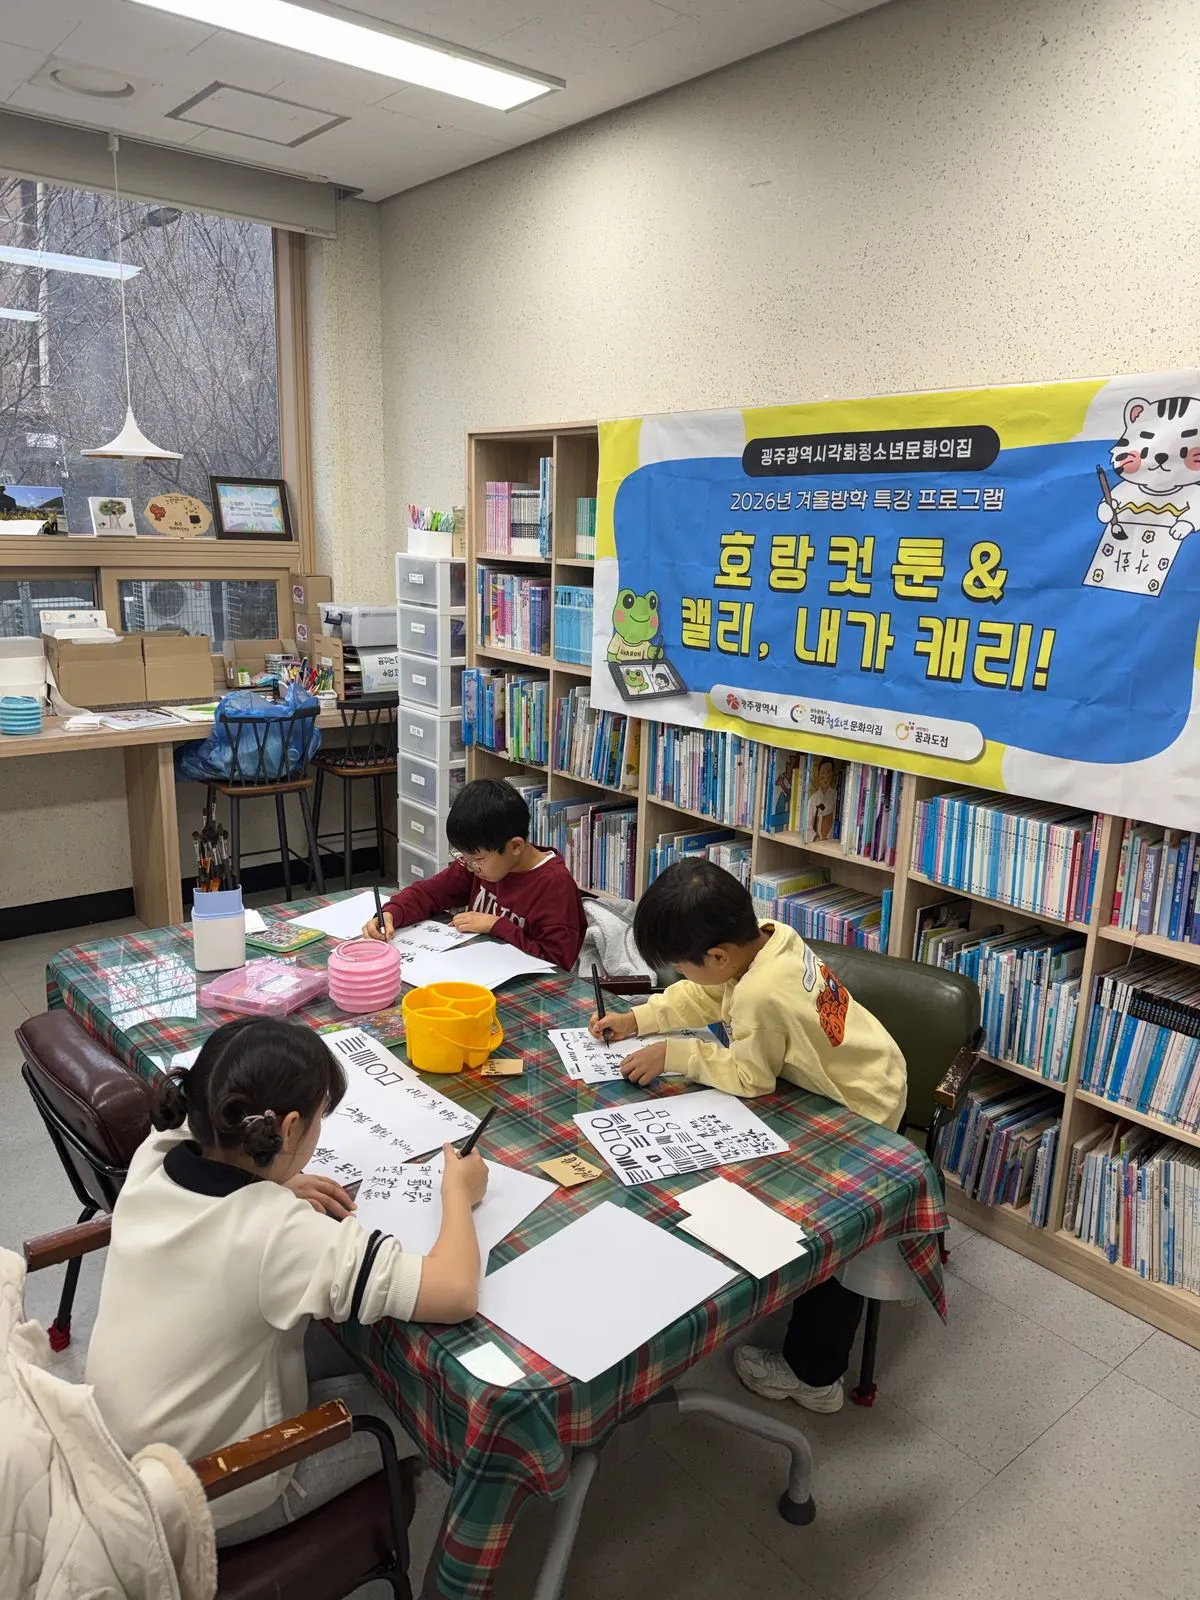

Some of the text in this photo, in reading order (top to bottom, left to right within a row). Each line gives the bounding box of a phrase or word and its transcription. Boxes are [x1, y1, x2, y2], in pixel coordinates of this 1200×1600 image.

[730, 487, 1005, 511] 2026년 겨울방학 특강 프로그램
[961, 540, 1008, 604] &
[680, 596, 1056, 691] 캘리, 내가 캐리!
[849, 720, 883, 736] 문화의집
[915, 731, 949, 748] 꿈과도전
